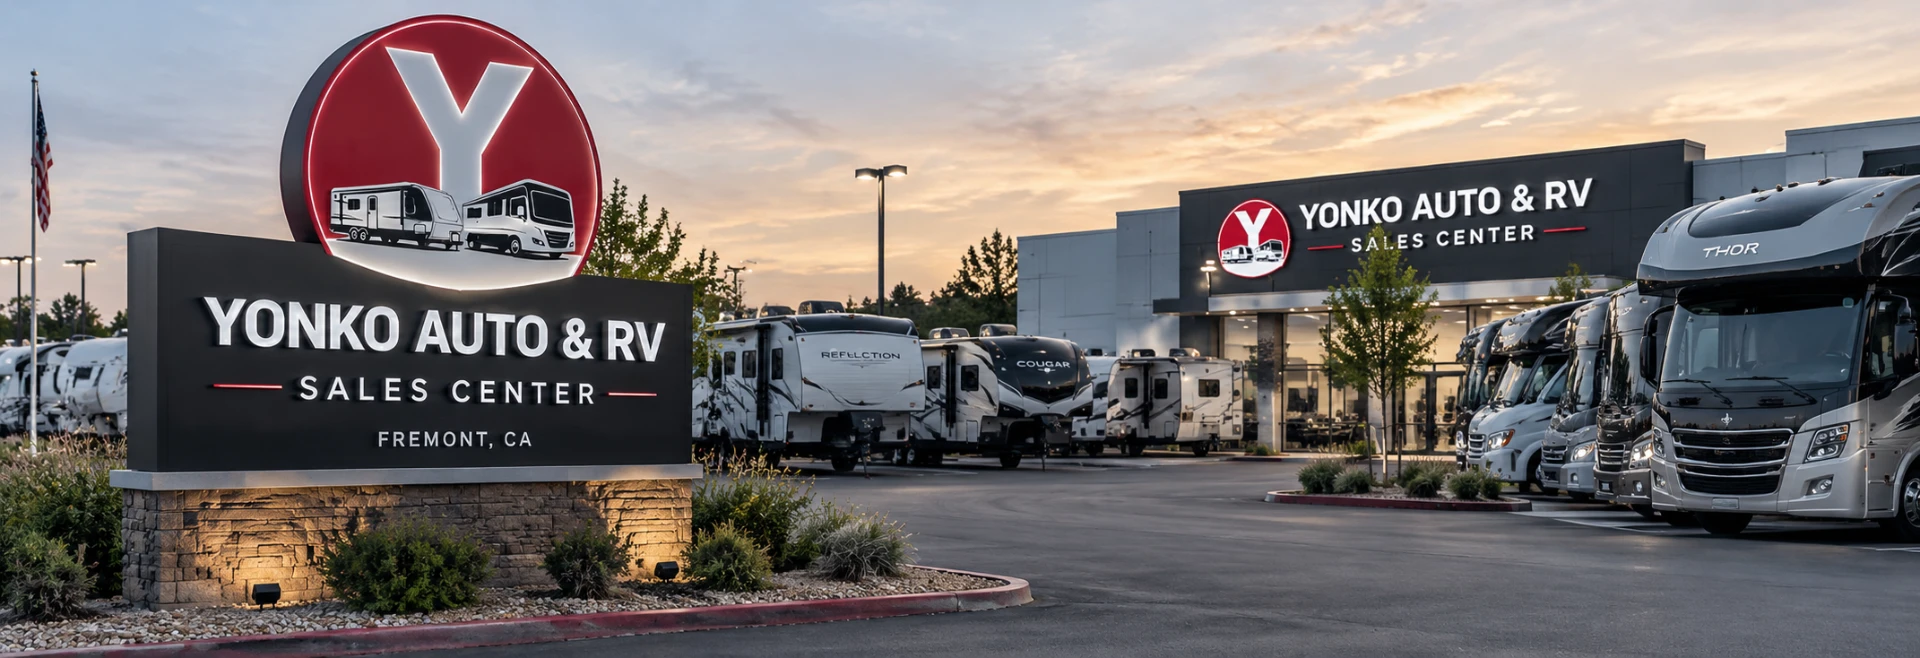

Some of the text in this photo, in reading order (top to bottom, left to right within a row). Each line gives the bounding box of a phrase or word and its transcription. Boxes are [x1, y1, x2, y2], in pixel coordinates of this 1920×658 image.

[385, 46, 534, 198] Y
[1298, 178, 1593, 230] YONKO AUTO & RV
[1234, 207, 1273, 248] Y
[1351, 224, 1534, 252] SALES CENTER
[1703, 242, 1760, 258] THOR
[204, 296, 666, 362] YONKO AUTO & RV
[1016, 360, 1071, 369] COUGAR
[300, 375, 595, 405] SALES CENTER
[378, 431, 532, 450] FREMONT, CA
